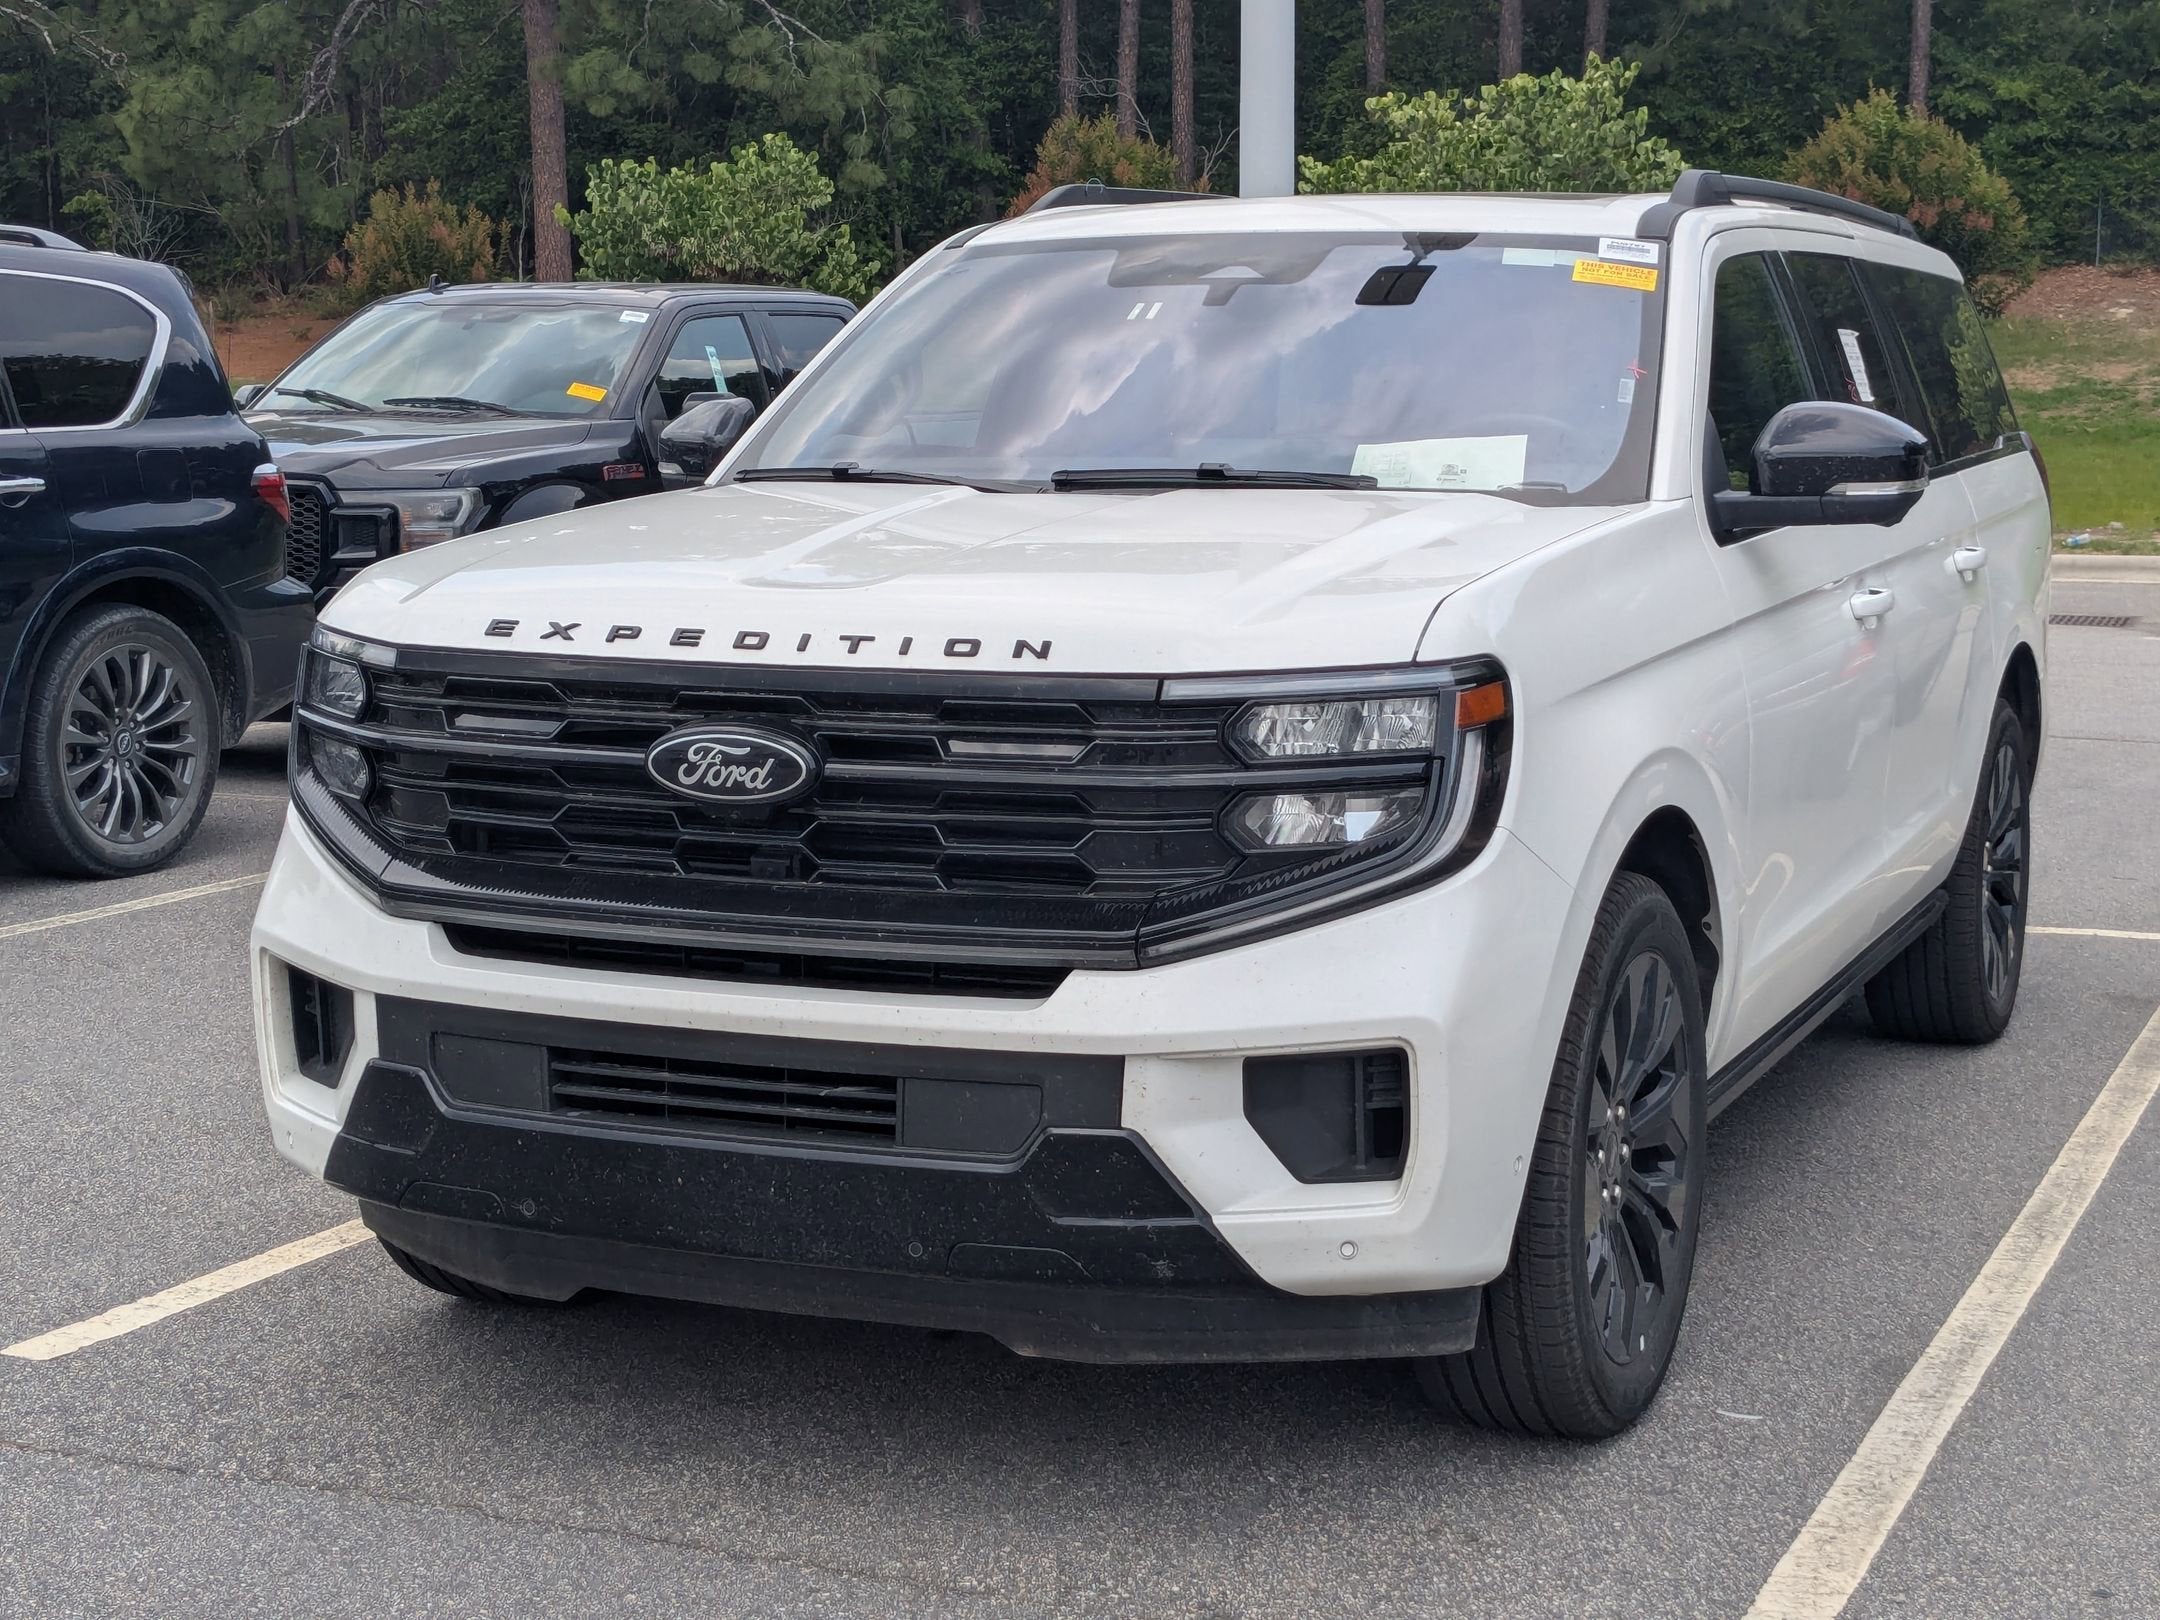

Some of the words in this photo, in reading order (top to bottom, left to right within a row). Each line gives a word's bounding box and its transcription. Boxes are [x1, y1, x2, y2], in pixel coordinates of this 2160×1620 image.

[1580, 261, 1605, 269] THIS
[1607, 264, 1654, 276] VEHICLE
[1626, 272, 1649, 280] SALE
[483, 617, 1053, 660] EXPEDITION
[677, 741, 774, 790] Ford
